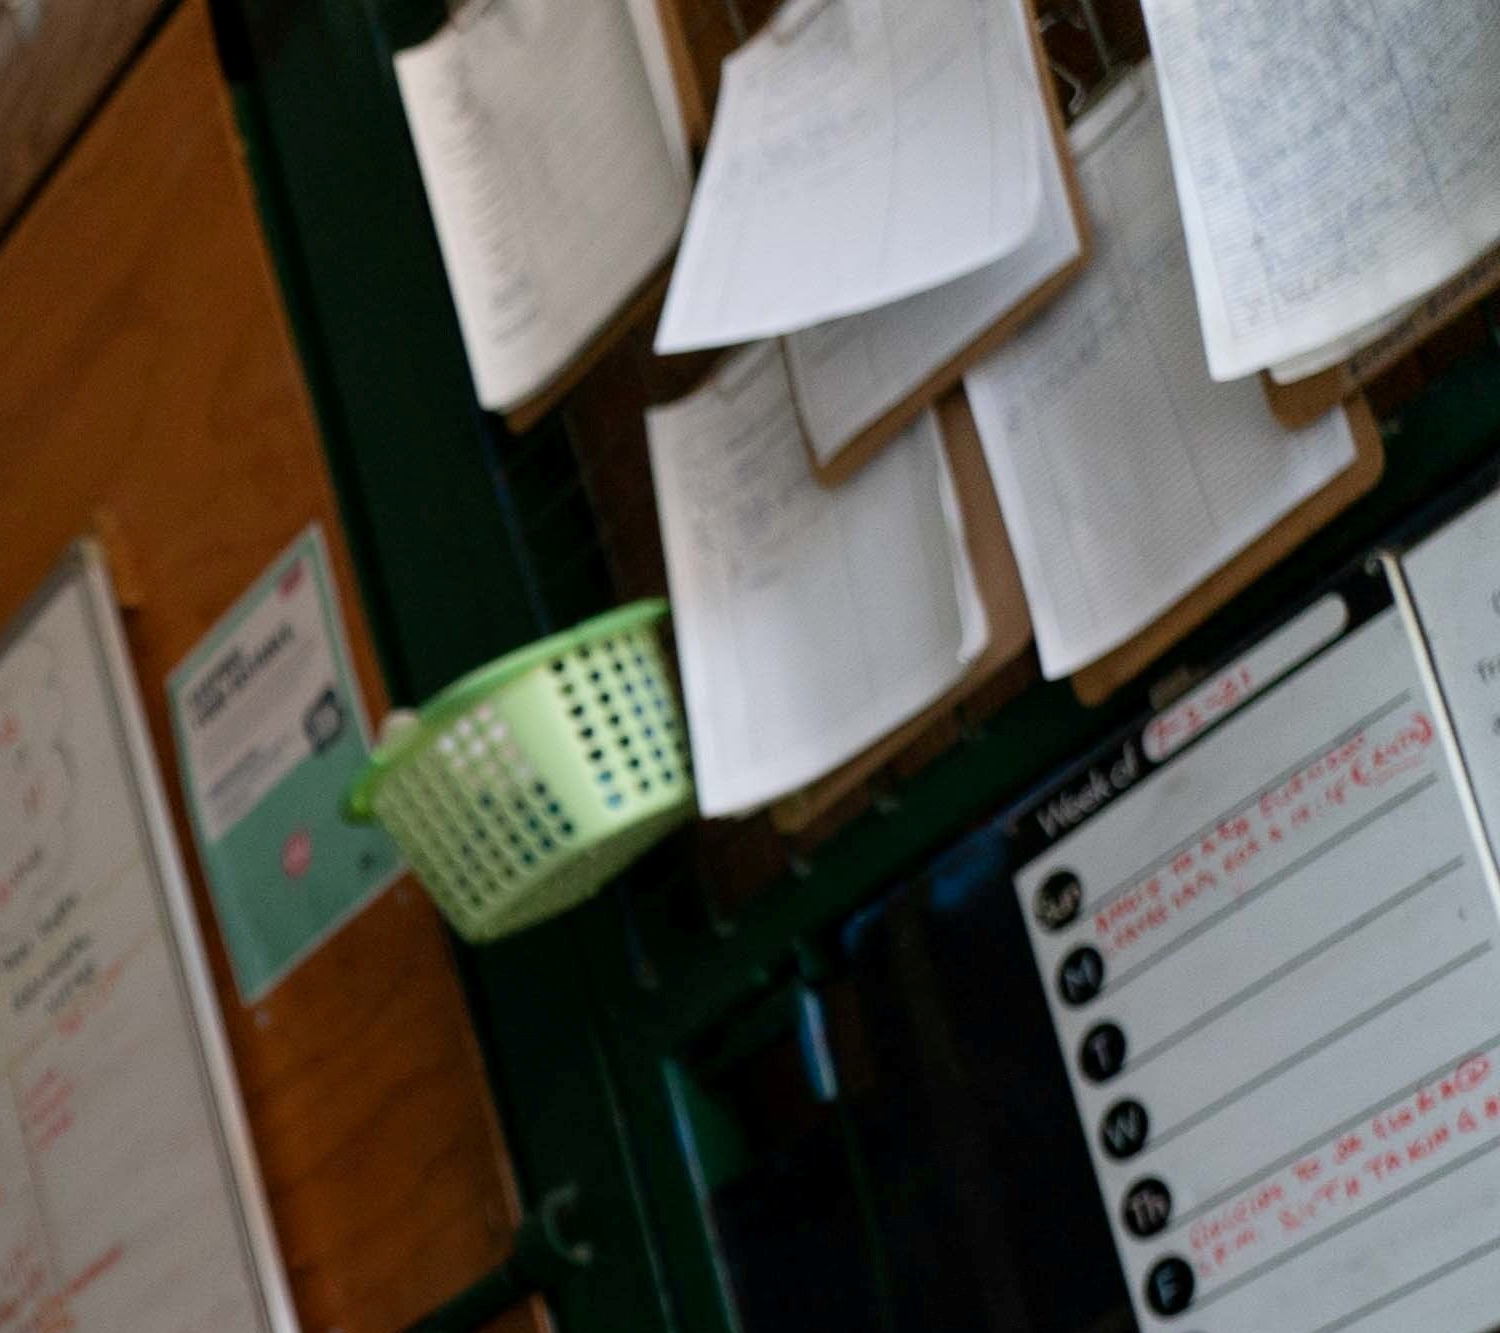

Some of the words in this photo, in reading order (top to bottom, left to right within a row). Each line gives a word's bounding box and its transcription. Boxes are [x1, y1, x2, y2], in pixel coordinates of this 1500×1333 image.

[1038, 766, 1109, 839] Week
[1109, 739, 1139, 790] of
[1063, 955, 1099, 992] M
[1103, 1102, 1141, 1148] W
[1125, 1186, 1169, 1232] Th
[1153, 1265, 1179, 1307] F
